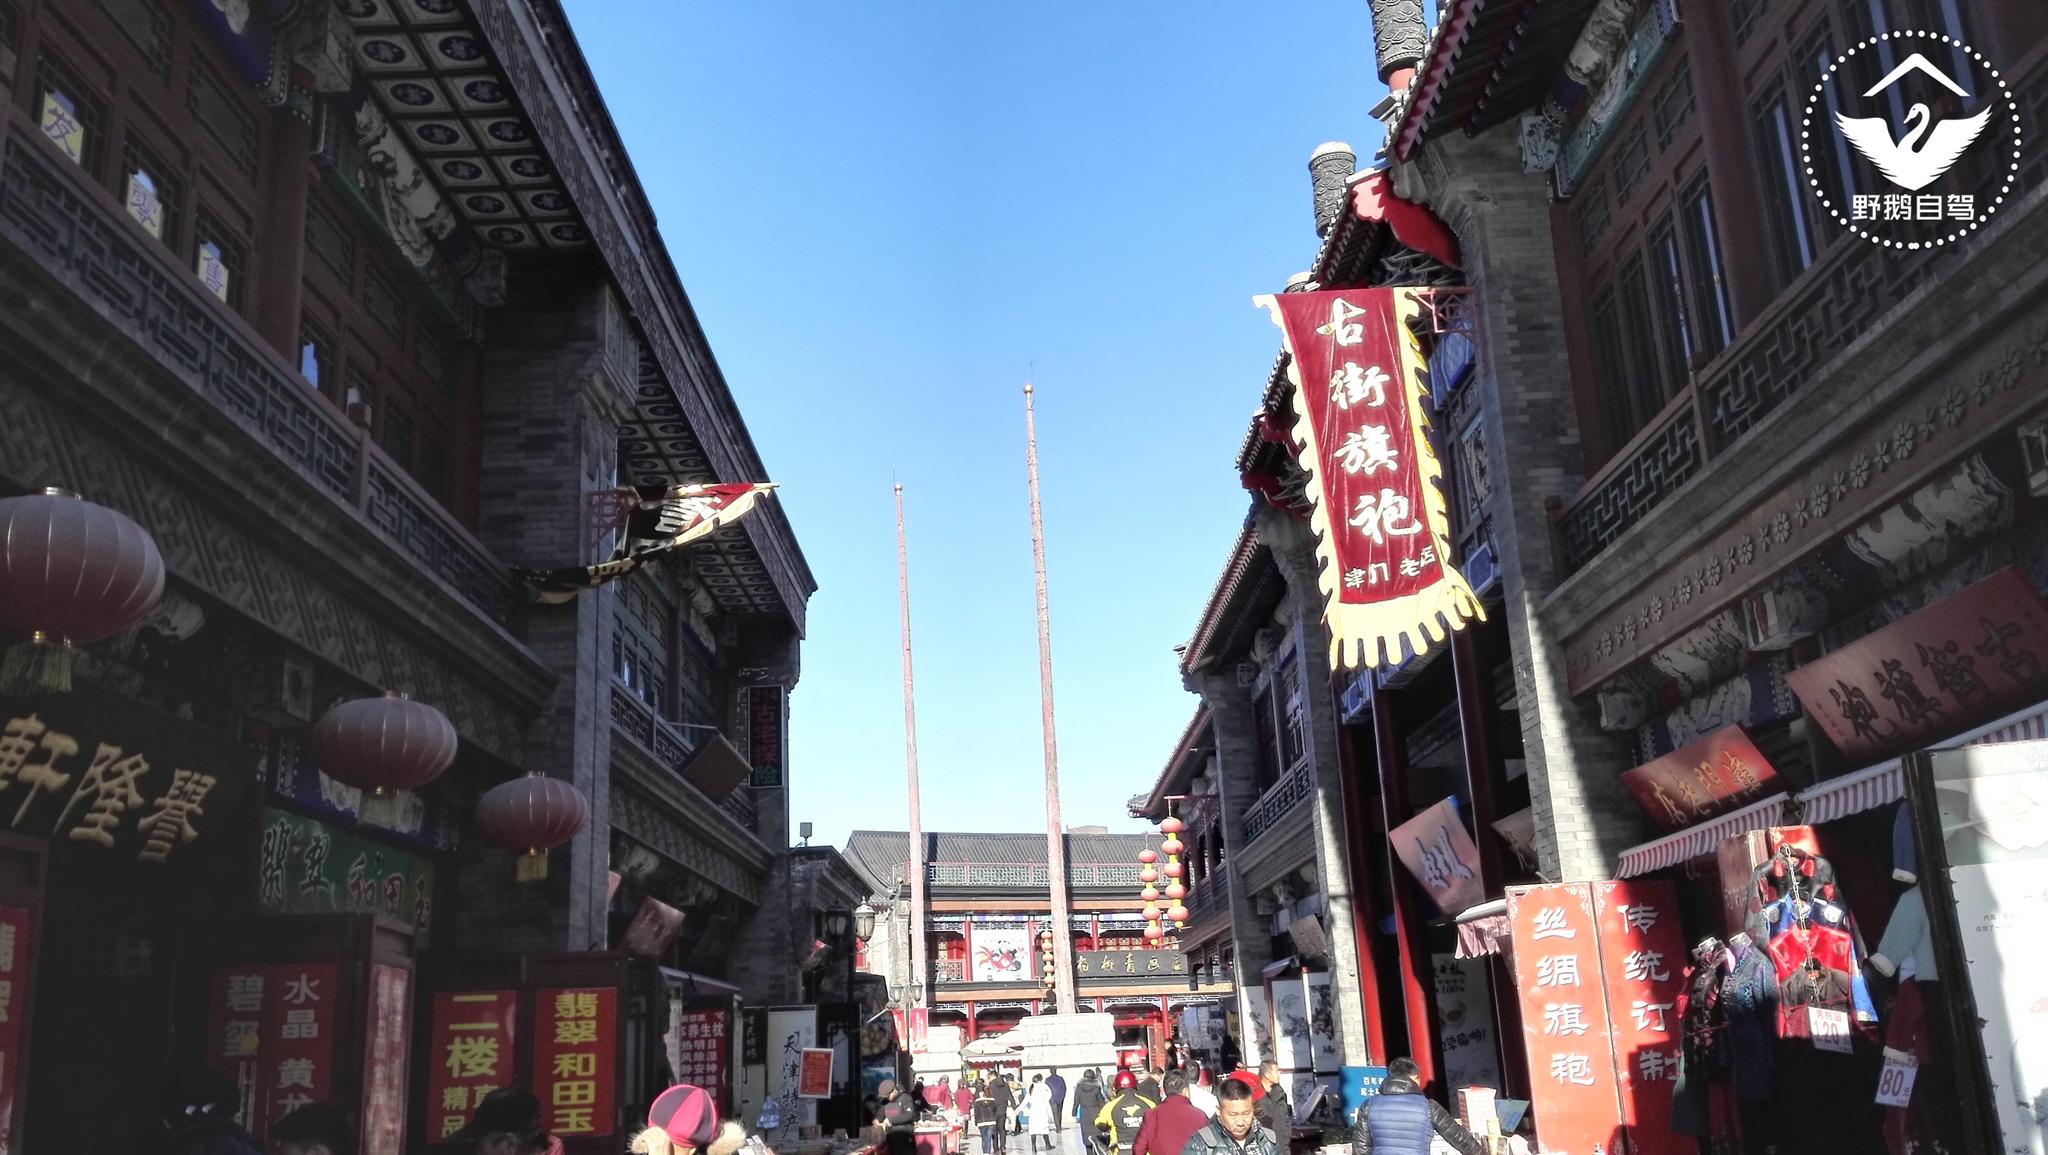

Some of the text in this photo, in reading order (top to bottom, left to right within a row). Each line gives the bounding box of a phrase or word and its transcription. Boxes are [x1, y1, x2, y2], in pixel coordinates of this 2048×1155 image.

[1316, 297, 1423, 547] 古街旗袍
[1343, 543, 1437, 589] 津门老店
[446, 994, 500, 1079] 二楼
[1532, 905, 1596, 1087] 丝绸旗袍
[1616, 902, 1681, 1084] 传统订制
[550, 992, 599, 1134] 翡翠和田玉
[782, 1031, 802, 1139] 天津特产
[1880, 1068, 1905, 1097] 80
